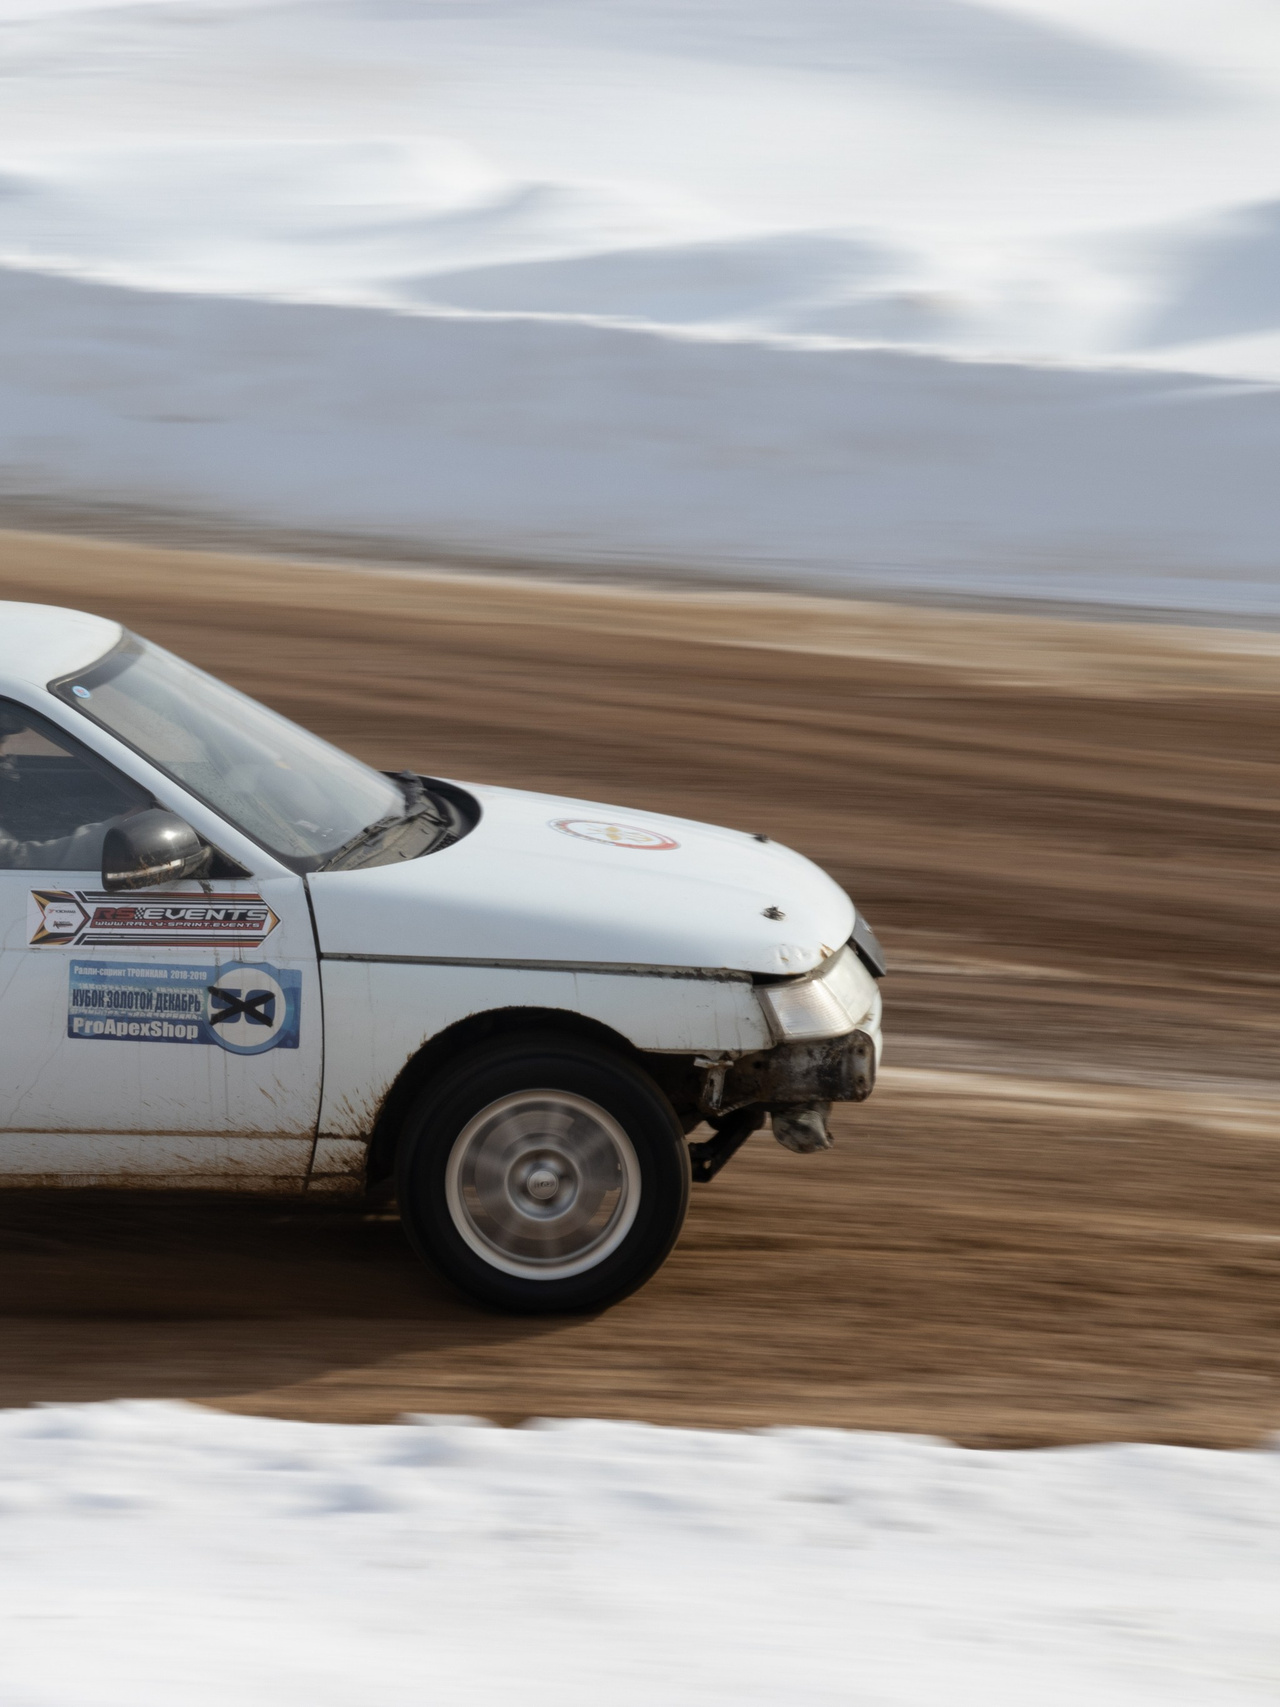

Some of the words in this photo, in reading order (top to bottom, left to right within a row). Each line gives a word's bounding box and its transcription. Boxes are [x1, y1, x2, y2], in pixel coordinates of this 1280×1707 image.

[93, 907, 137, 919] RS
[142, 908, 268, 921] EVENTS
[74, 965, 126, 977] Ралли-спринт
[170, 970, 207, 980] 2018-2019
[72, 989, 105, 1008] КУБОК
[106, 988, 153, 1010] ЗОЛОТОЙ
[155, 992, 201, 1013] ДЕКАБРЬ
[73, 1017, 199, 1040] ProApexShop
